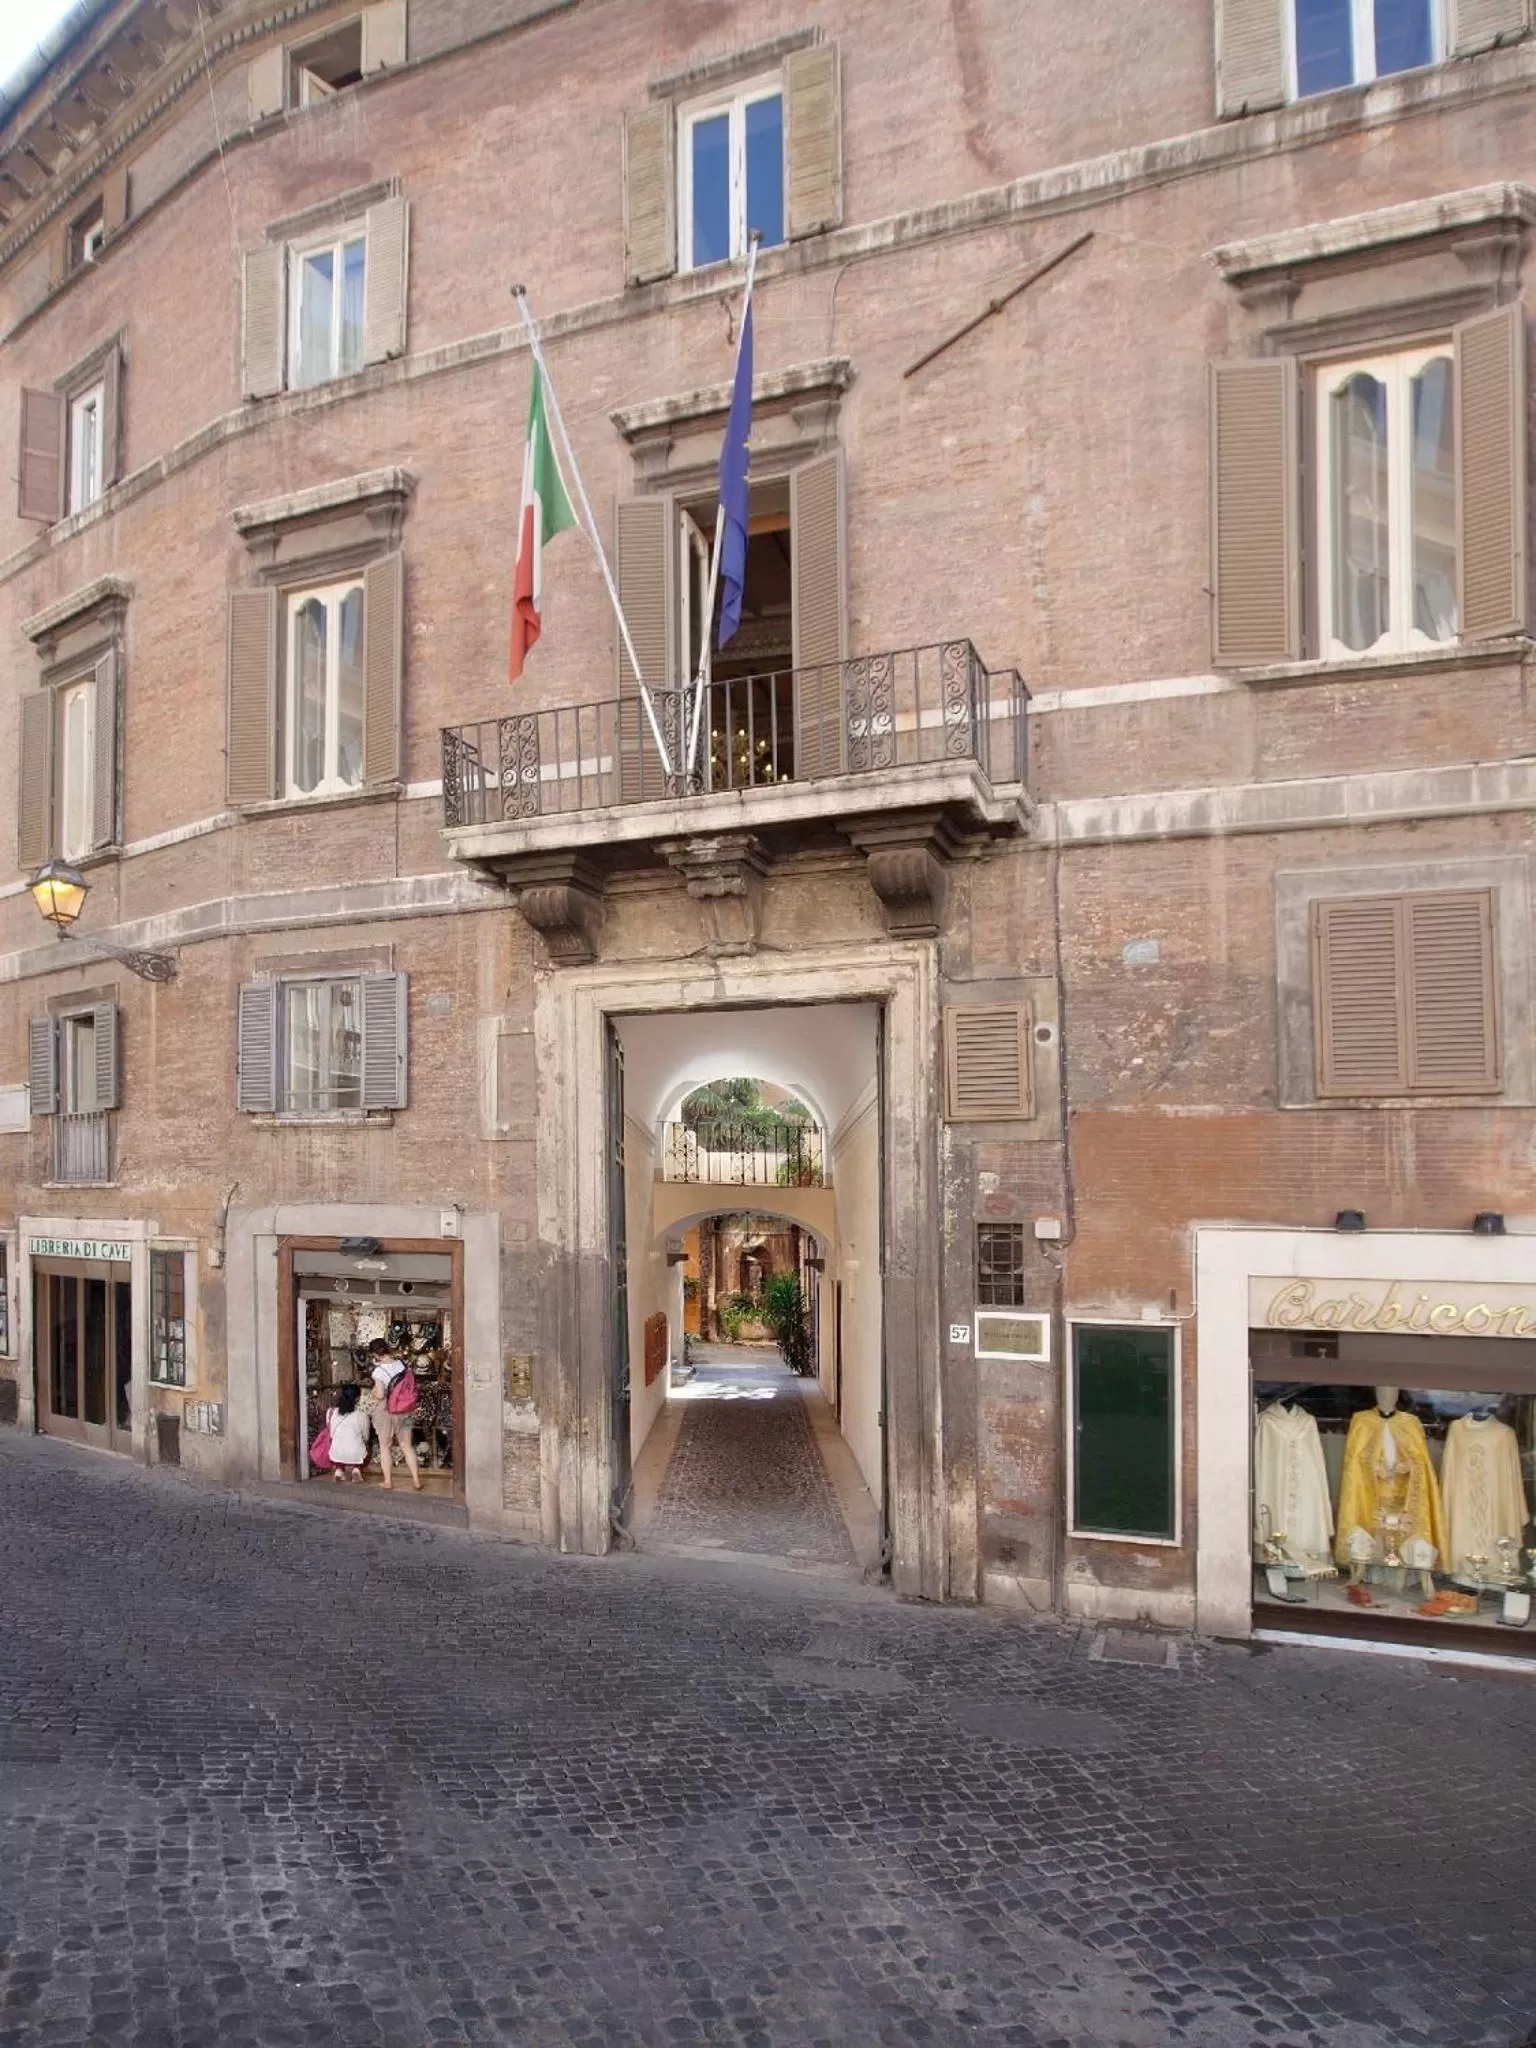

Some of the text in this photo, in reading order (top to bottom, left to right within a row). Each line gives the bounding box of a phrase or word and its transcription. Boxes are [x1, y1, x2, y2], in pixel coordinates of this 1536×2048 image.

[30, 1239, 129, 1259] LIBRERIA DI CAVE
[1267, 1279, 1536, 1336] Barbicon
[951, 1326, 968, 1340] 57
